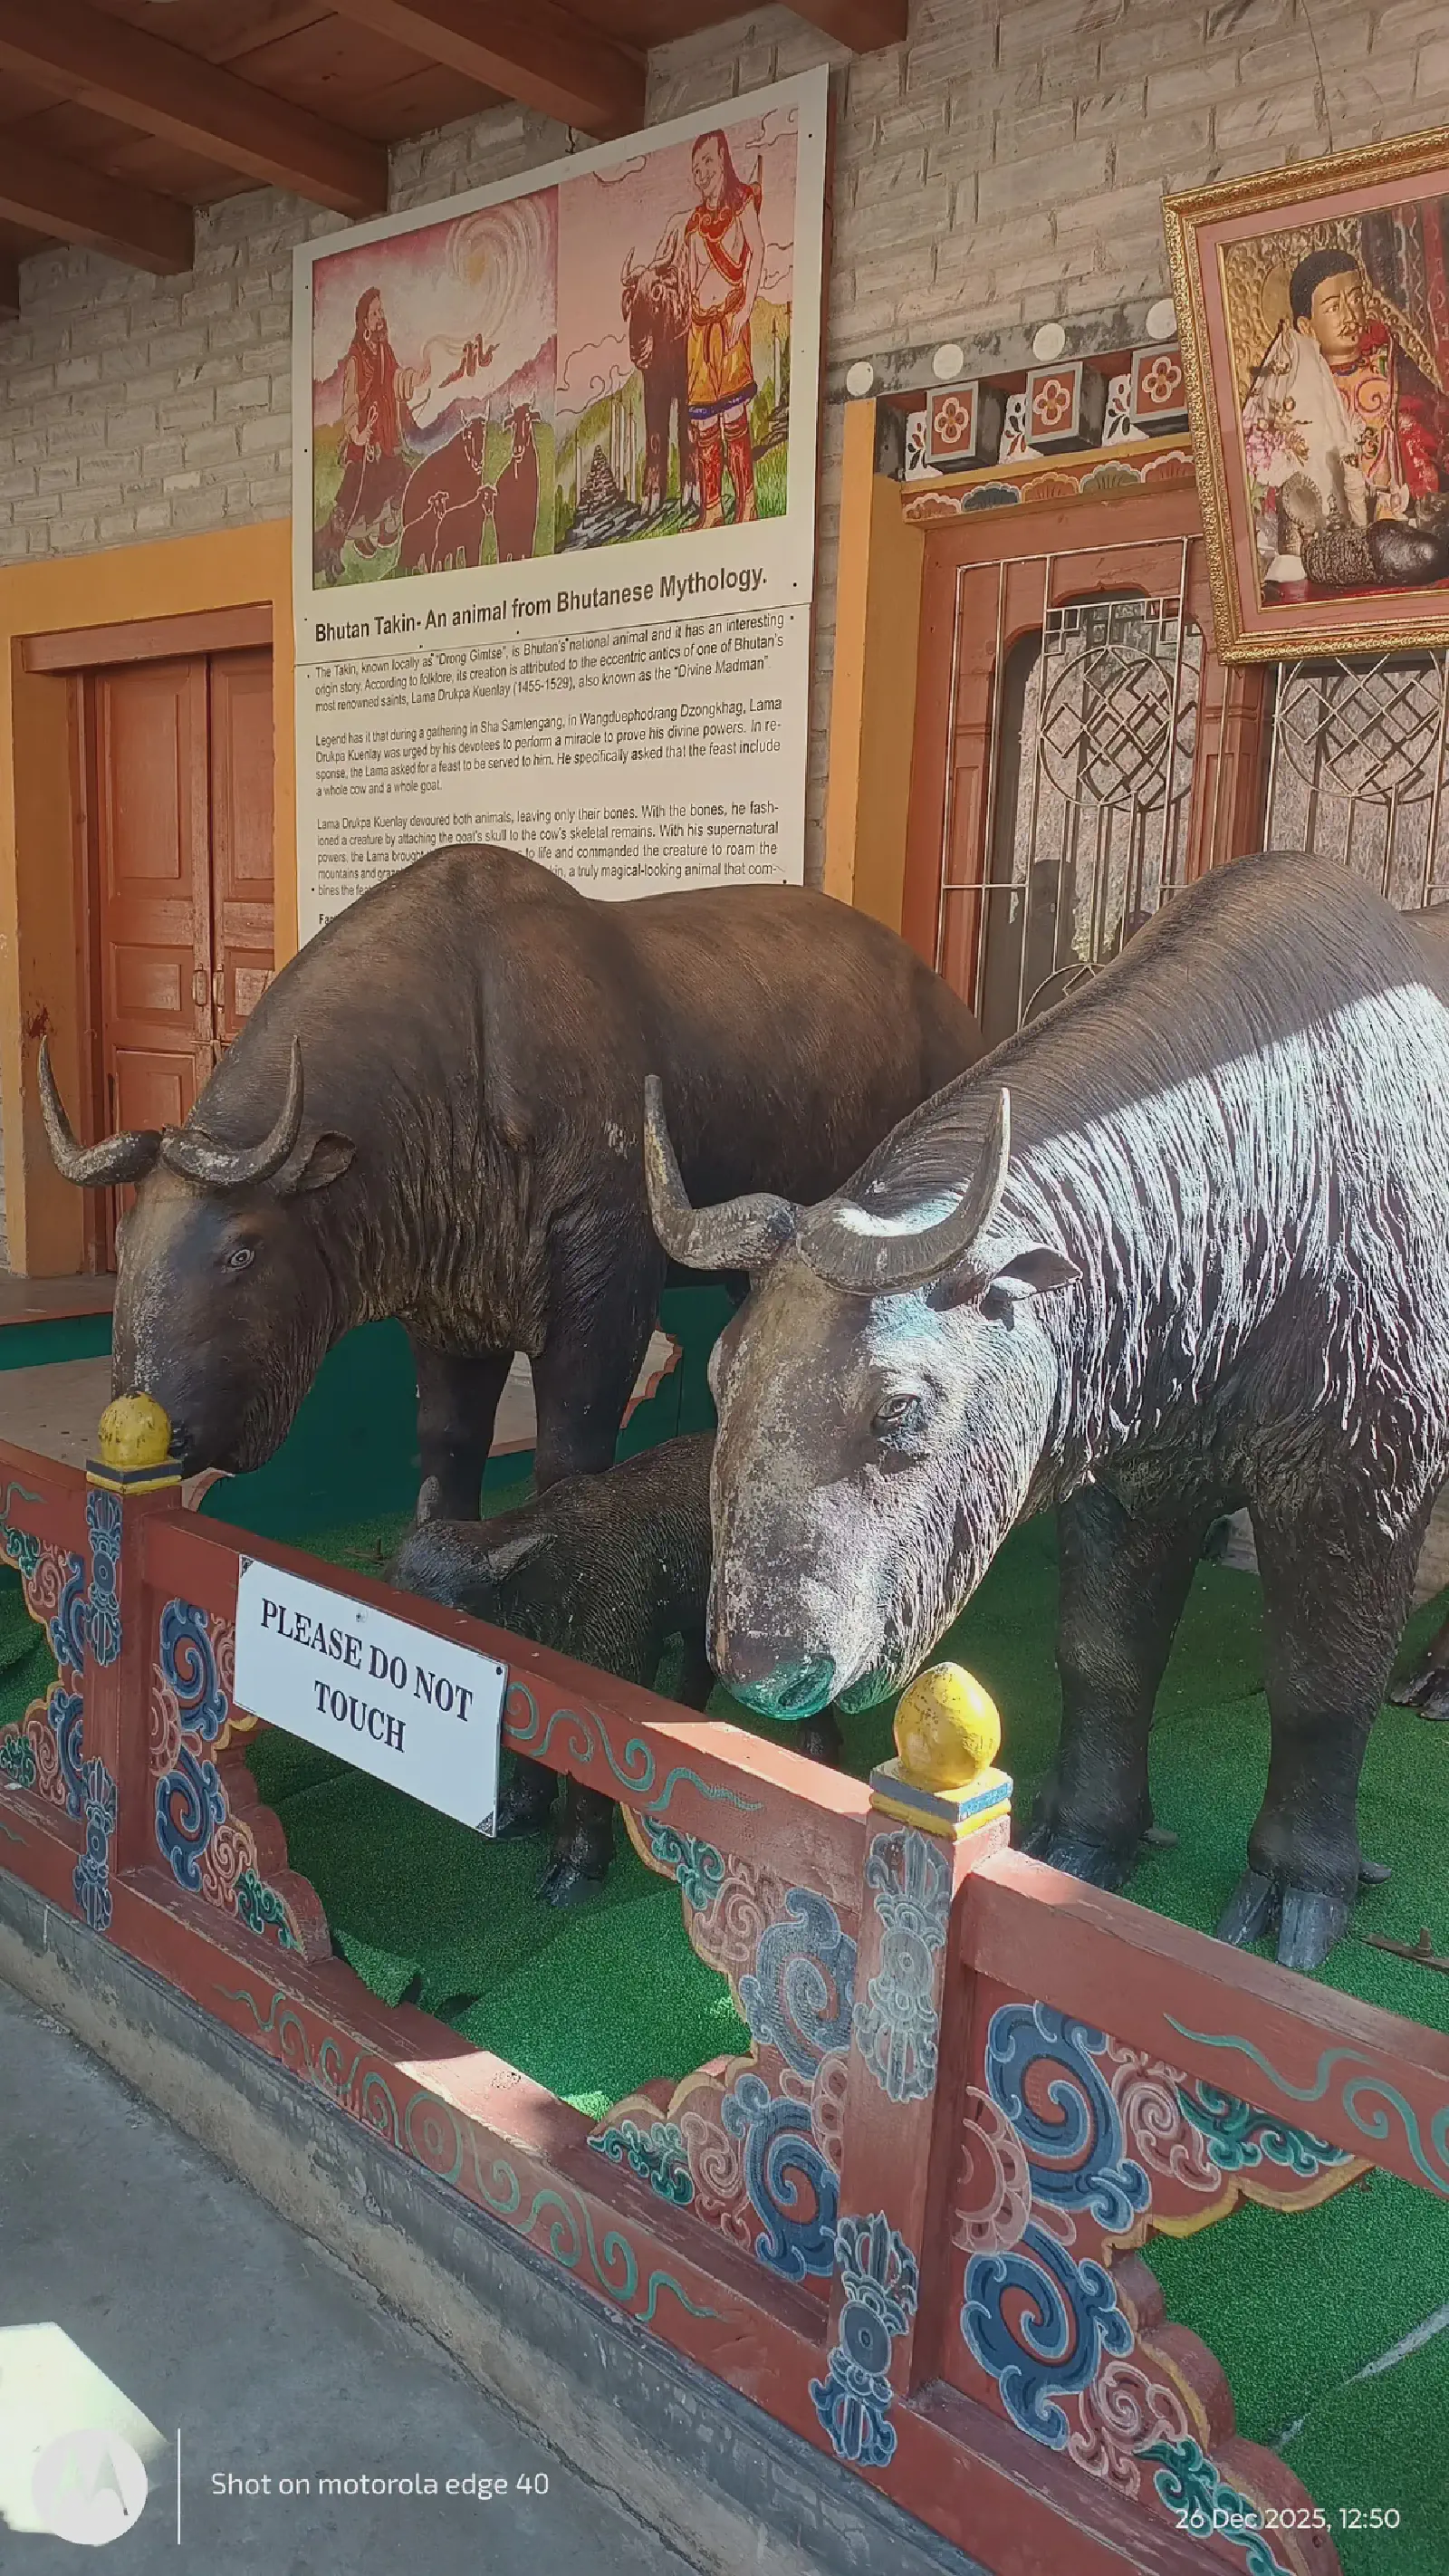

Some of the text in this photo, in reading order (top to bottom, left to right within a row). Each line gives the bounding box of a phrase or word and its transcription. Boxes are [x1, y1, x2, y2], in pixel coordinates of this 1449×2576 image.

[315, 567, 768, 642] Bhutan Takin- An animal from Bhutanese Mythology.
[315, 666, 331, 678] The
[361, 661, 389, 673] known
[391, 656, 420, 671] locally
[523, 639, 566, 656] Bhutan's
[569, 634, 609, 650] national
[612, 630, 648, 646] animal
[651, 627, 671, 641] and
[686, 624, 704, 638] has
[708, 624, 722, 635] an
[726, 615, 784, 633] interesting
[315, 681, 339, 697] origin
[364, 675, 407, 690] According
[409, 673, 417, 686] to
[469, 664, 507, 679] creation
[520, 657, 565, 674] attributed
[569, 656, 578, 668] to
[581, 654, 597, 668] the
[600, 649, 647, 665] eccentric
[648, 645, 680, 660] antics
[683, 642, 696, 657] of
[697, 643, 717, 655] one
[721, 639, 732, 652] of
[734, 632, 783, 651] Bhutan's
[315, 698, 336, 712] most
[337, 694, 379, 709] renowned
[411, 690, 436, 703] Lama
[437, 687, 471, 702] Drukpa
[473, 683, 510, 697] Kuenlay
[578, 674, 600, 687] also
[601, 672, 636, 686] known
[654, 667, 671, 680] the
[315, 732, 346, 749] Legend
[348, 732, 363, 744] has
[372, 728, 389, 742] that
[390, 727, 417, 742] during
[426, 723, 467, 741] gathering
[480, 720, 499, 734] Sha
[568, 714, 577, 726] in
[749, 699, 782, 712] Lama
[315, 719, 782, 764] Drukpa Kuenlay was urged by his devotees to perform miracle to prove his divine powers. In re-
[350, 764, 363, 777] the
[365, 764, 389, 776] Lama
[390, 761, 416, 774] asked
[438, 758, 461, 772] feast
[463, 757, 472, 770] to
[474, 757, 485, 770] be
[488, 755, 520, 769] served
[522, 754, 531, 766] to
[533, 753, 554, 766] him.
[557, 752, 571, 764] He
[574, 747, 629, 766] specifically
[630, 745, 663, 760] asked
[666, 744, 686, 758] that
[688, 743, 706, 756] the
[709, 740, 738, 755] feast
[739, 738, 781, 754] include
[323, 783, 348, 796] whole
[350, 784, 366, 795] cow
[369, 781, 384, 793] and
[394, 780, 418, 793] whole
[317, 818, 341, 830] Lama
[342, 816, 371, 831] Drukpa
[373, 815, 408, 831] Kuenlay
[409, 812, 450, 827] devoured
[453, 812, 473, 825] both
[475, 811, 514, 825] animals,
[517, 810, 552, 825] leaving
[554, 808, 575, 824] only
[578, 807, 600, 821] their
[603, 807, 638, 820] bones.
[641, 804, 667, 819] With
[669, 804, 686, 817] the
[731, 802, 746, 815] he
[750, 801, 779, 814] fash-
[350, 831, 384, 845] creature
[385, 831, 396, 847] by
[398, 831, 437, 846] attaching
[438, 830, 453, 842] the
[485, 828, 507, 841] skull
[509, 828, 519, 841] to
[521, 828, 537, 841] the
[539, 827, 566, 841] cow's
[570, 825, 608, 840] skeletal
[611, 824, 656, 839] remains.
[659, 823, 685, 837] With
[687, 823, 704, 837] his
[706, 821, 779, 840] supernatural
[538, 841, 777, 859] life and commanded the creature to roam the
[578, 862, 776, 881] truly magical-looking animal that com-
[261, 1598, 473, 1721] PLEASE DO NOT
[314, 1680, 406, 1753] TOUCH
